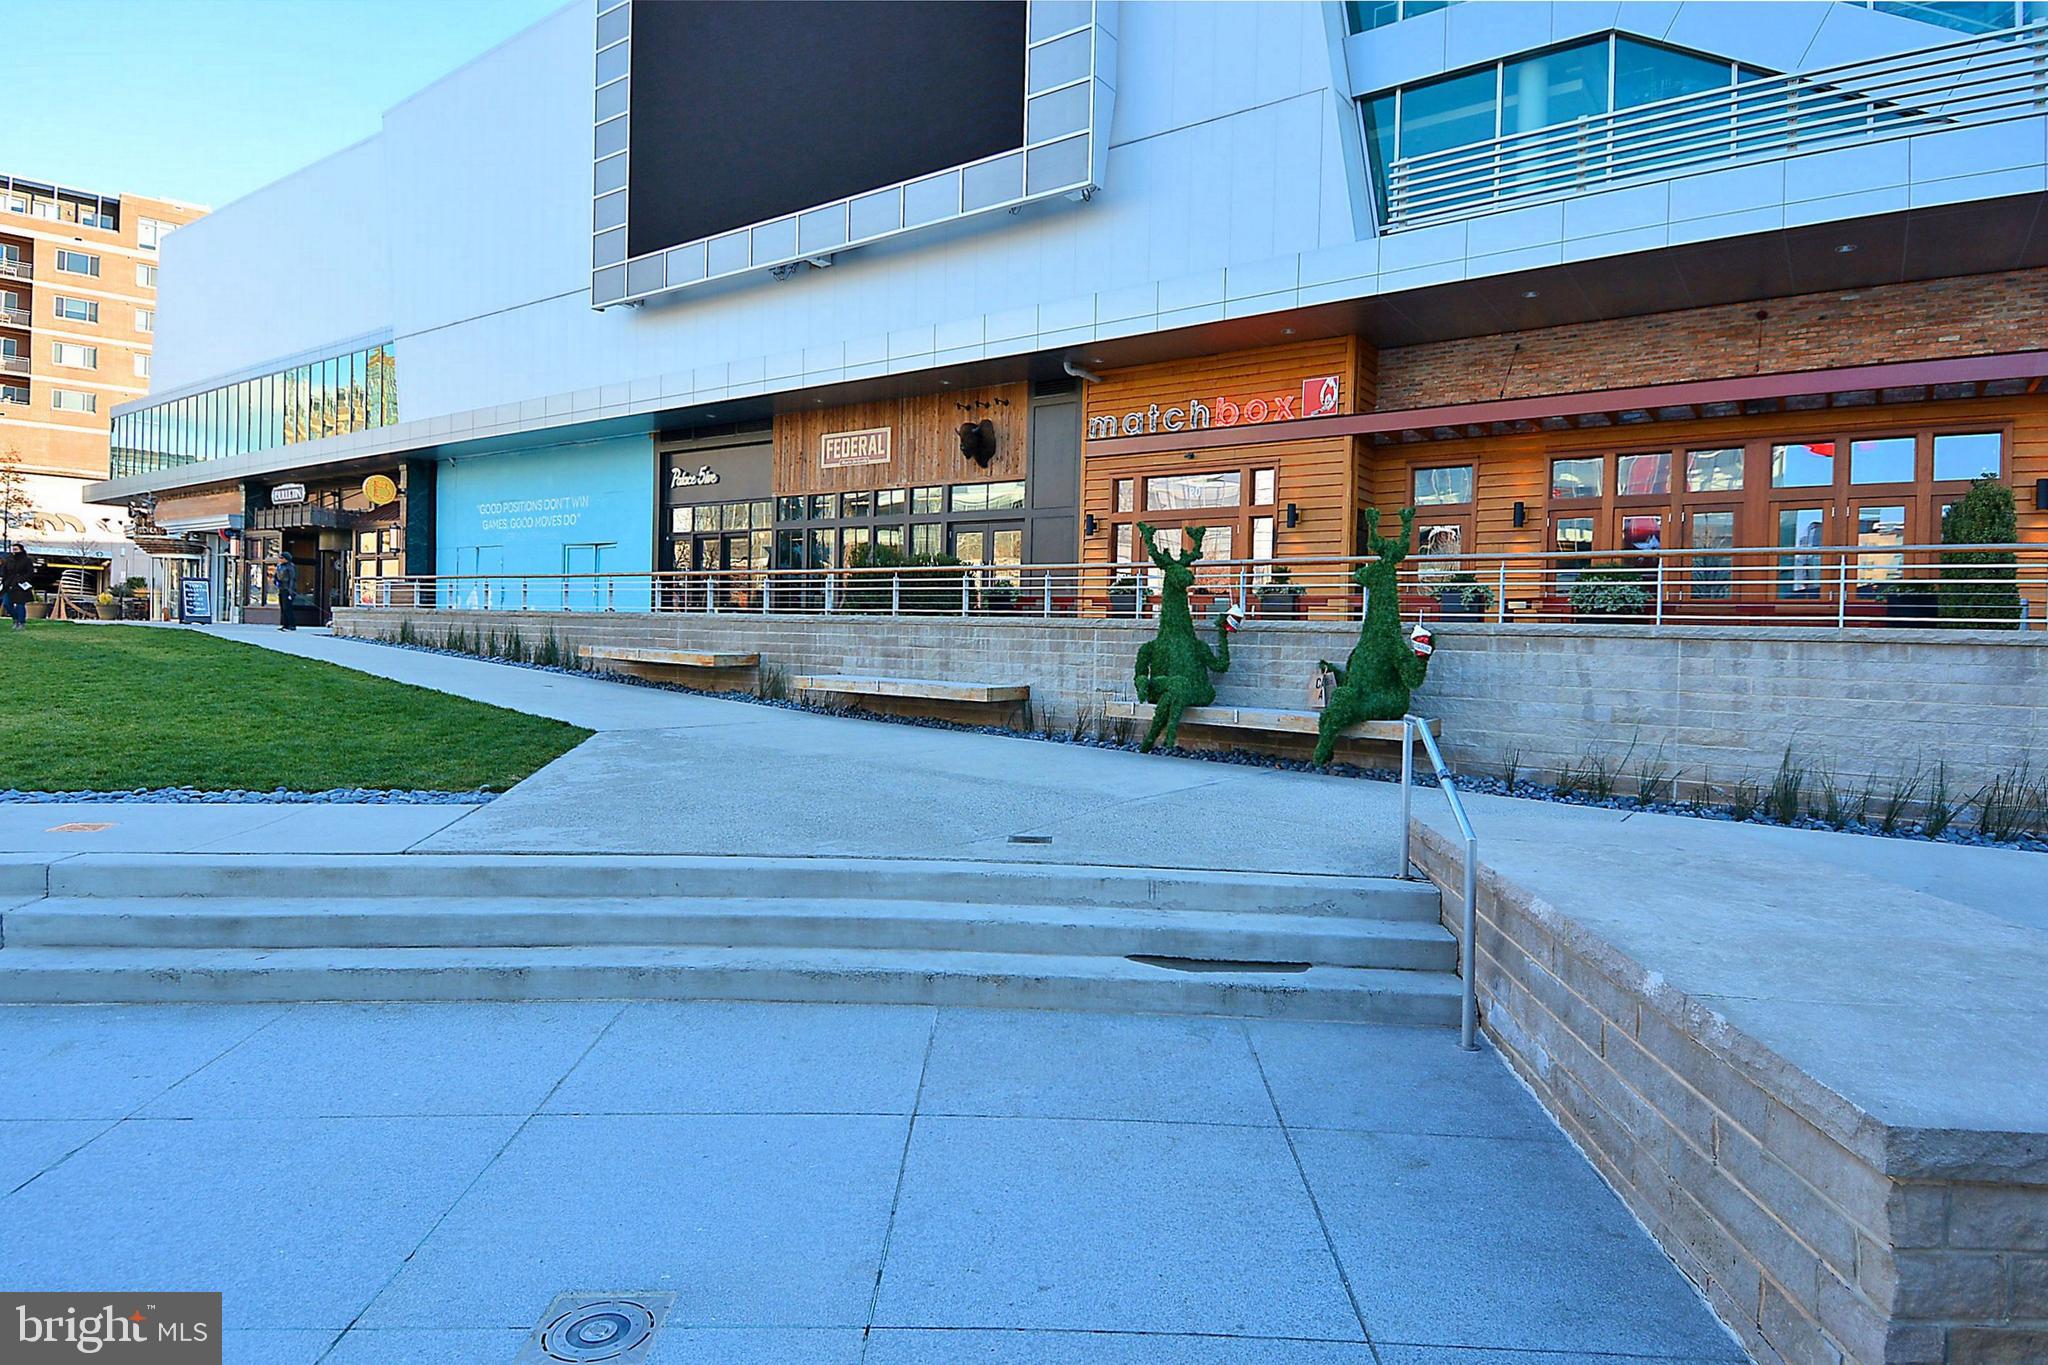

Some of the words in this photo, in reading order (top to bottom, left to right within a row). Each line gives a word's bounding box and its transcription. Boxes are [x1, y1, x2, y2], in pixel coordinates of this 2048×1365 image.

[1089, 397, 1295, 438] matchbox
[826, 434, 885, 459] FEDERAL
[503, 500, 542, 513] POSITIONS
[571, 495, 589, 508] WIN
[511, 518, 533, 529] GOOD
[535, 515, 561, 527] MOVES
